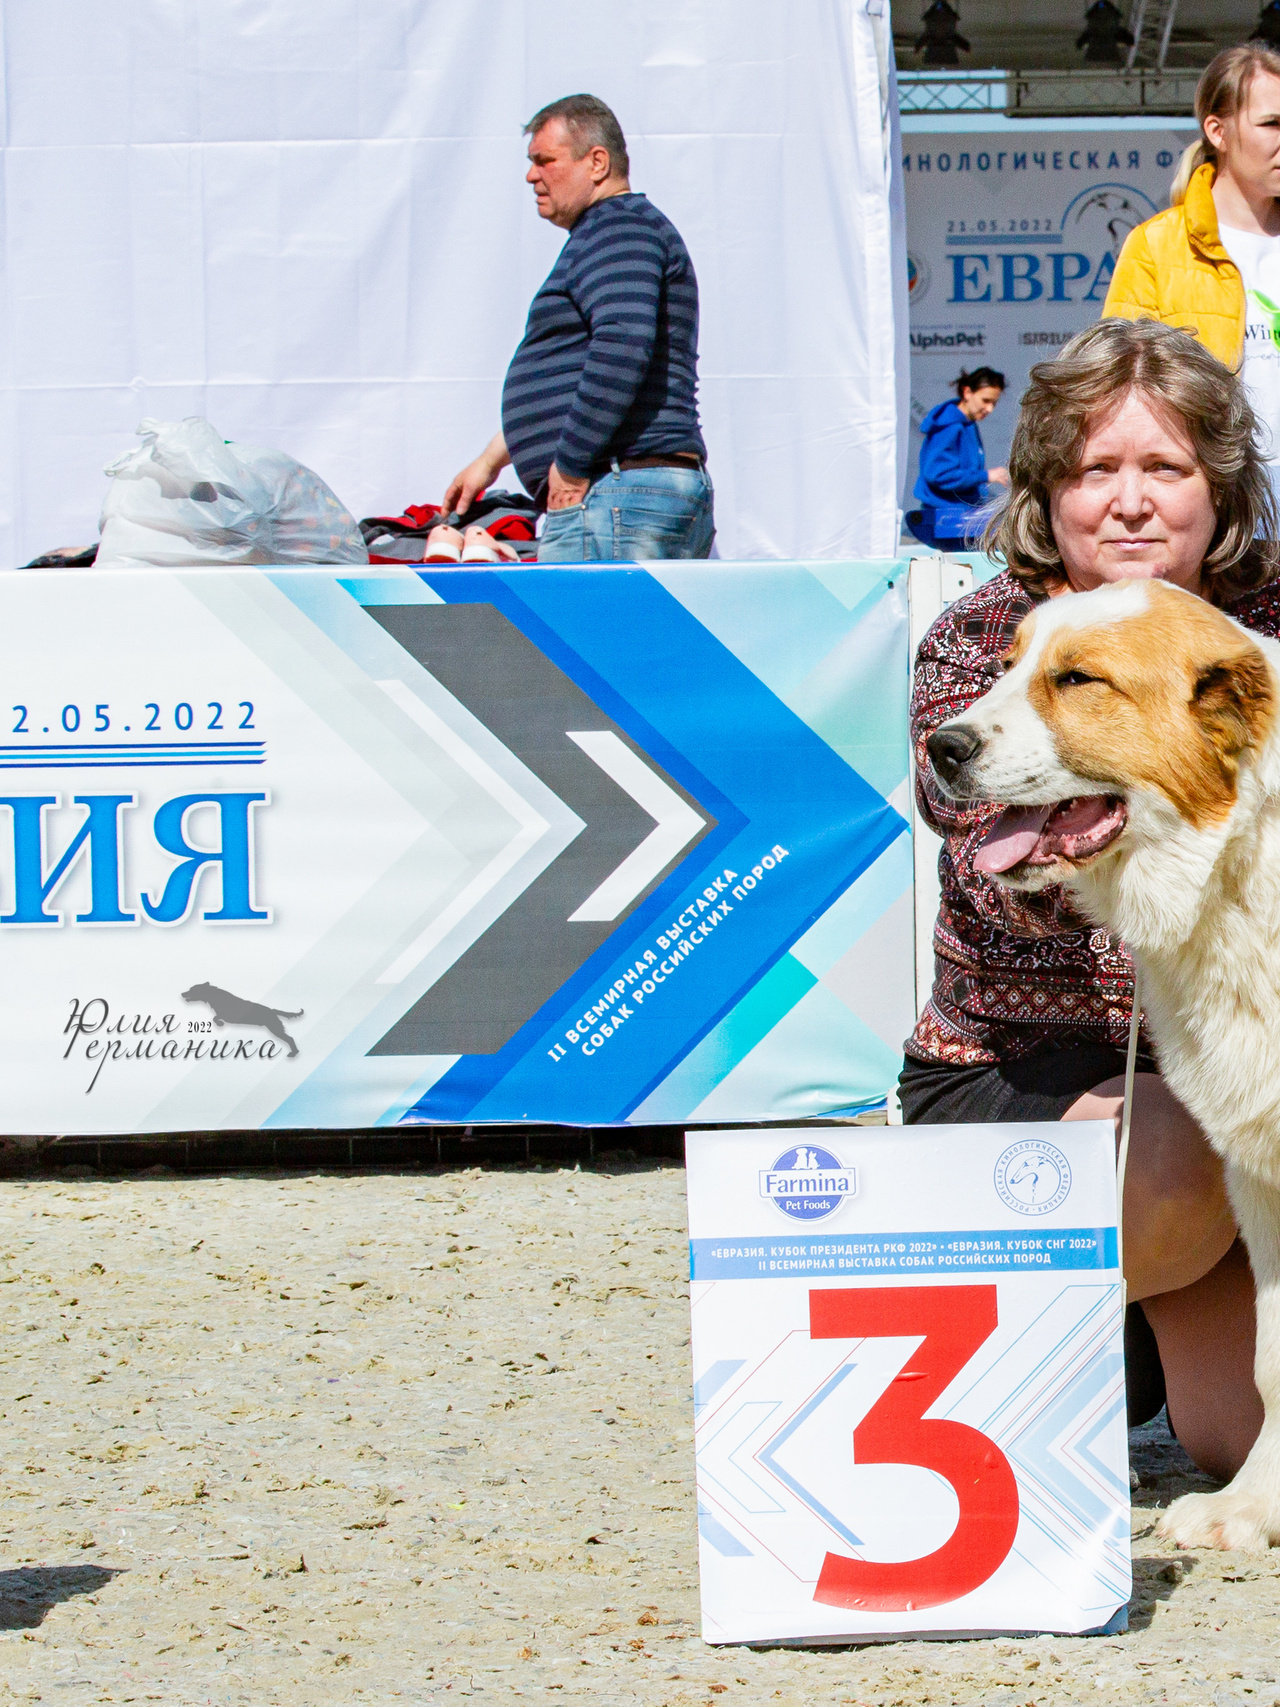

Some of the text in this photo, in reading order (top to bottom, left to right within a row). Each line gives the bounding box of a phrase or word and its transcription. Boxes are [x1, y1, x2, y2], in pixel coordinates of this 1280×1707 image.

[947, 219, 1053, 233] 21.05.2022
[0, 792, 269, 924] ИЯ
[565, 949, 658, 1045] ВСЕМИРНАЯ
[655, 868, 738, 951] ВЫСТАВКА
[581, 844, 790, 1057] СОБАК РОССИЙСКИХ ПОРОД
[766, 1173, 849, 1193] Farmina
[786, 1199, 831, 1210] Pet Foods
[771, 1246, 807, 1257] КУБОК
[810, 1243, 880, 1256] ПРЕЗИДЕНТА
[883, 1243, 906, 1253] РКФ
[909, 1242, 938, 1253] 2022»
[1007, 1239, 1043, 1250] КУБОК
[1046, 1239, 1066, 1250] СНГ
[1069, 1238, 1097, 1249] 2022»
[769, 1258, 835, 1270] ВСЕМИРНАЯ
[838, 1257, 895, 1268] ВЫСТАВКА
[900, 1255, 935, 1266] СОБАК
[938, 1252, 1010, 1265] РОССИЙСКИХ
[1013, 1252, 1052, 1264] ПОРОД
[808, 1284, 1020, 1612] 3
